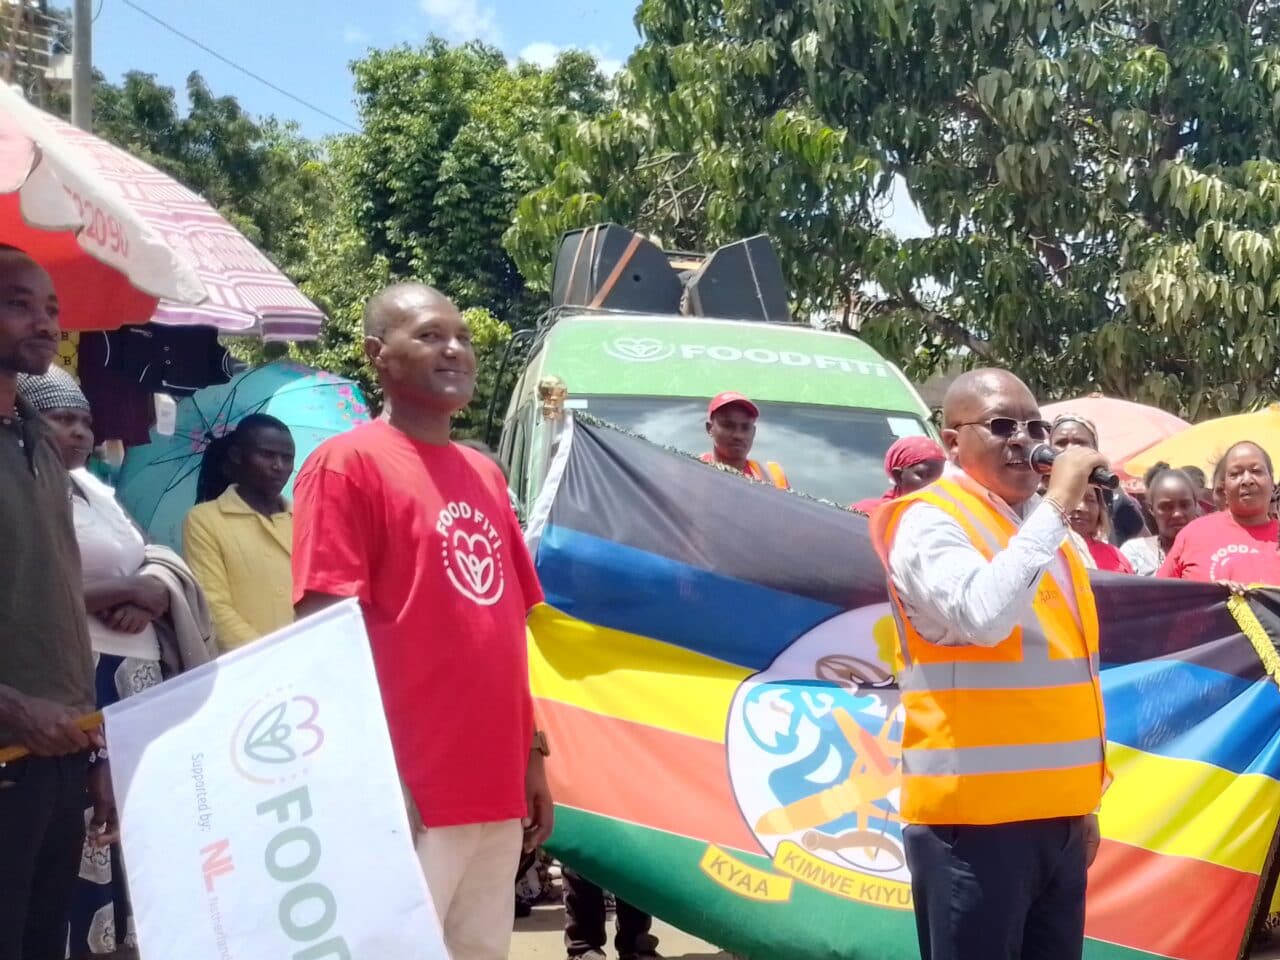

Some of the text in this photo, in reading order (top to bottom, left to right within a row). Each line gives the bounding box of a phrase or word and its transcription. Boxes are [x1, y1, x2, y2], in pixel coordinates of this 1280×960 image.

[191, 752, 210, 811] Supported
[200, 837, 235, 893] NL
[709, 854, 769, 897] KYAA
[782, 850, 912, 905] KIMWE KIYU
